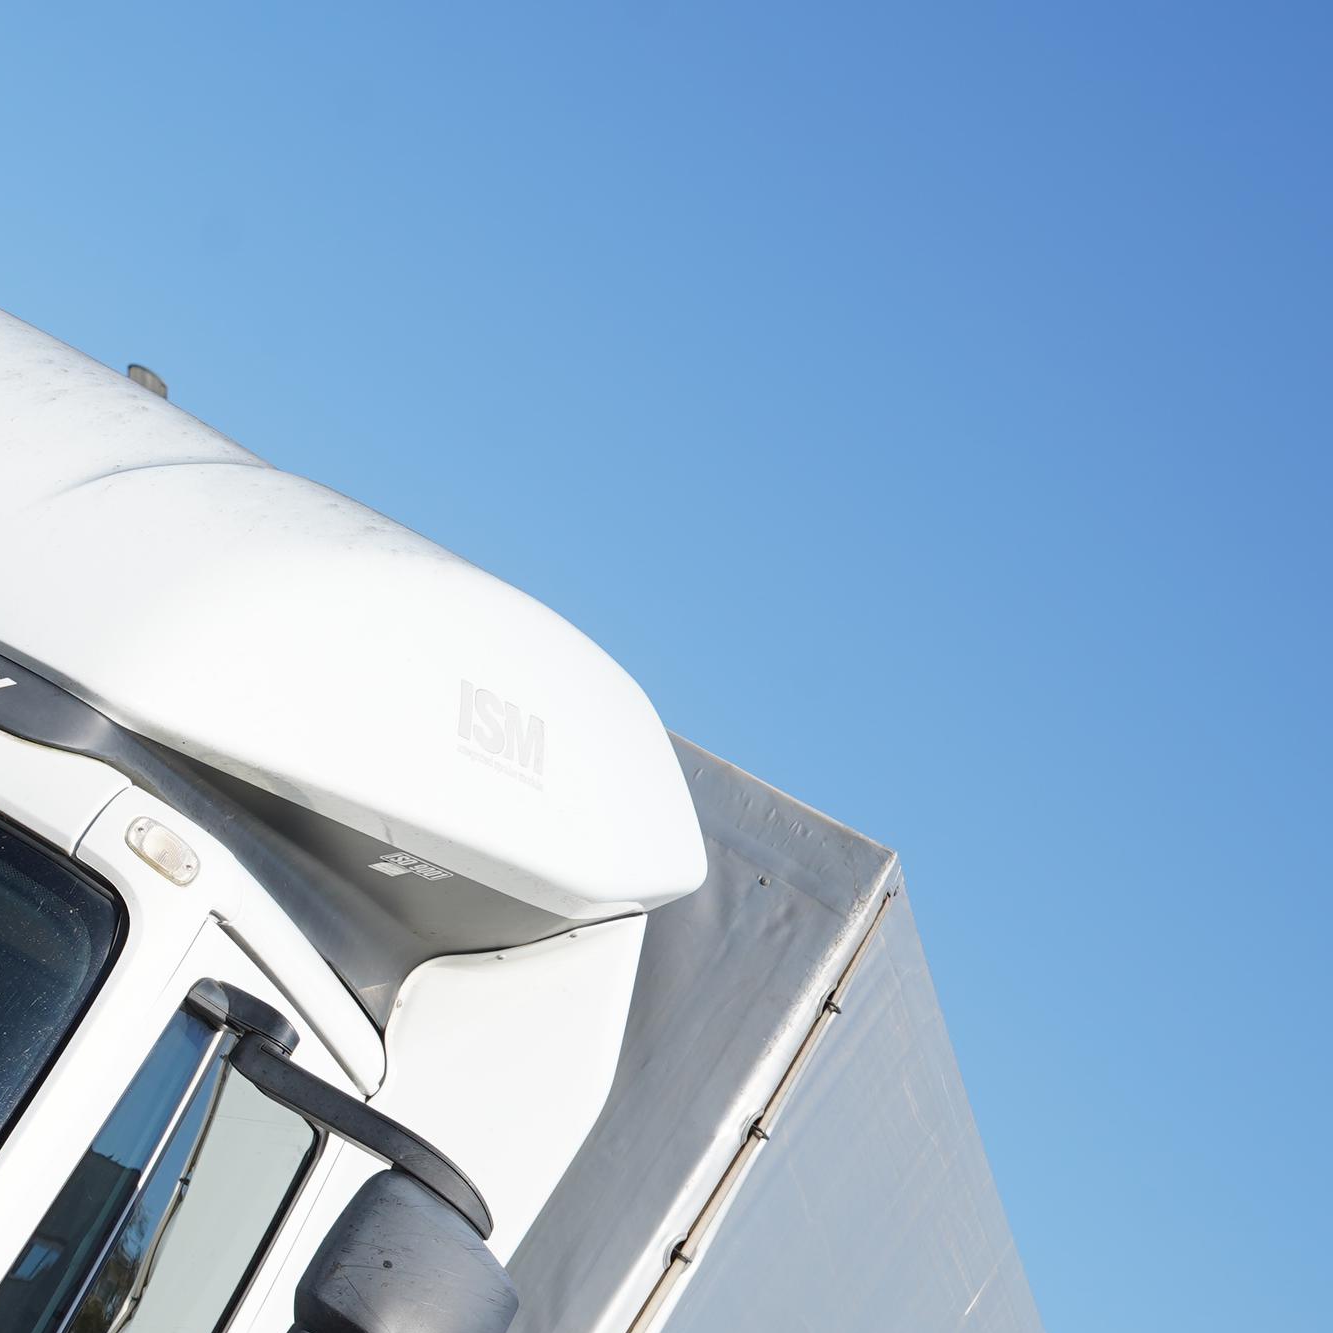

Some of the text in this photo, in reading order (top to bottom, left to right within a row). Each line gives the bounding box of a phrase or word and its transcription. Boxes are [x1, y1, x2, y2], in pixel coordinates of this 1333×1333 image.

[457, 678, 545, 776] ISM
[383, 852, 418, 866] ISO
[409, 863, 449, 879] 9001
